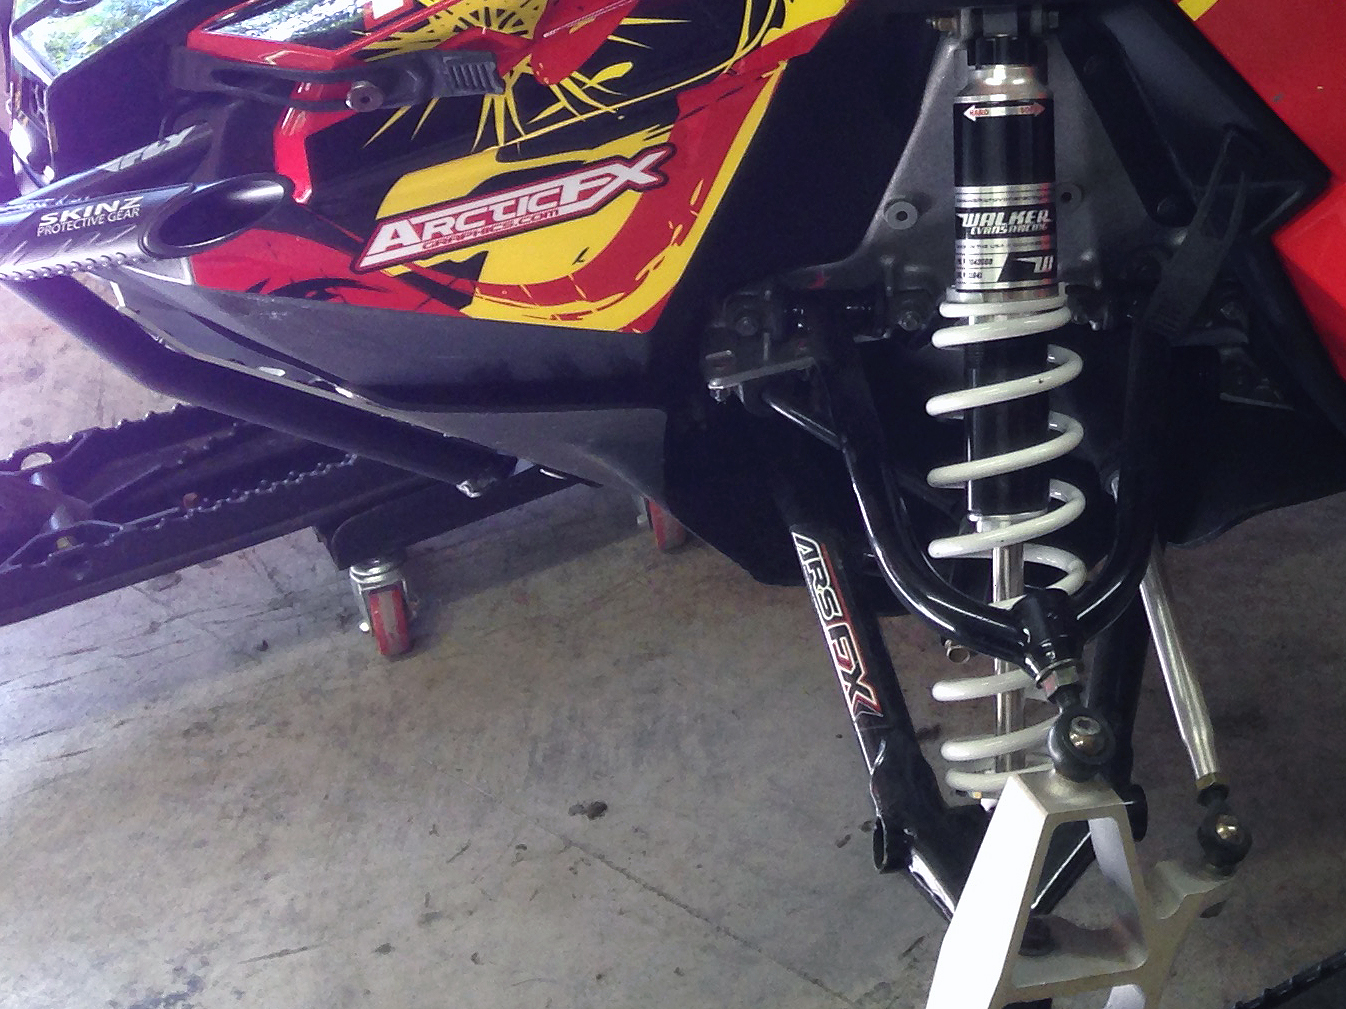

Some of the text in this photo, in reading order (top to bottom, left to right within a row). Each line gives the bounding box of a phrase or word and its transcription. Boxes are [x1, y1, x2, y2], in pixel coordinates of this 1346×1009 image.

[37, 207, 141, 237] PROTECTIVE GEAR
[38, 196, 144, 227] SKINZ
[955, 209, 1053, 228] WALKER
